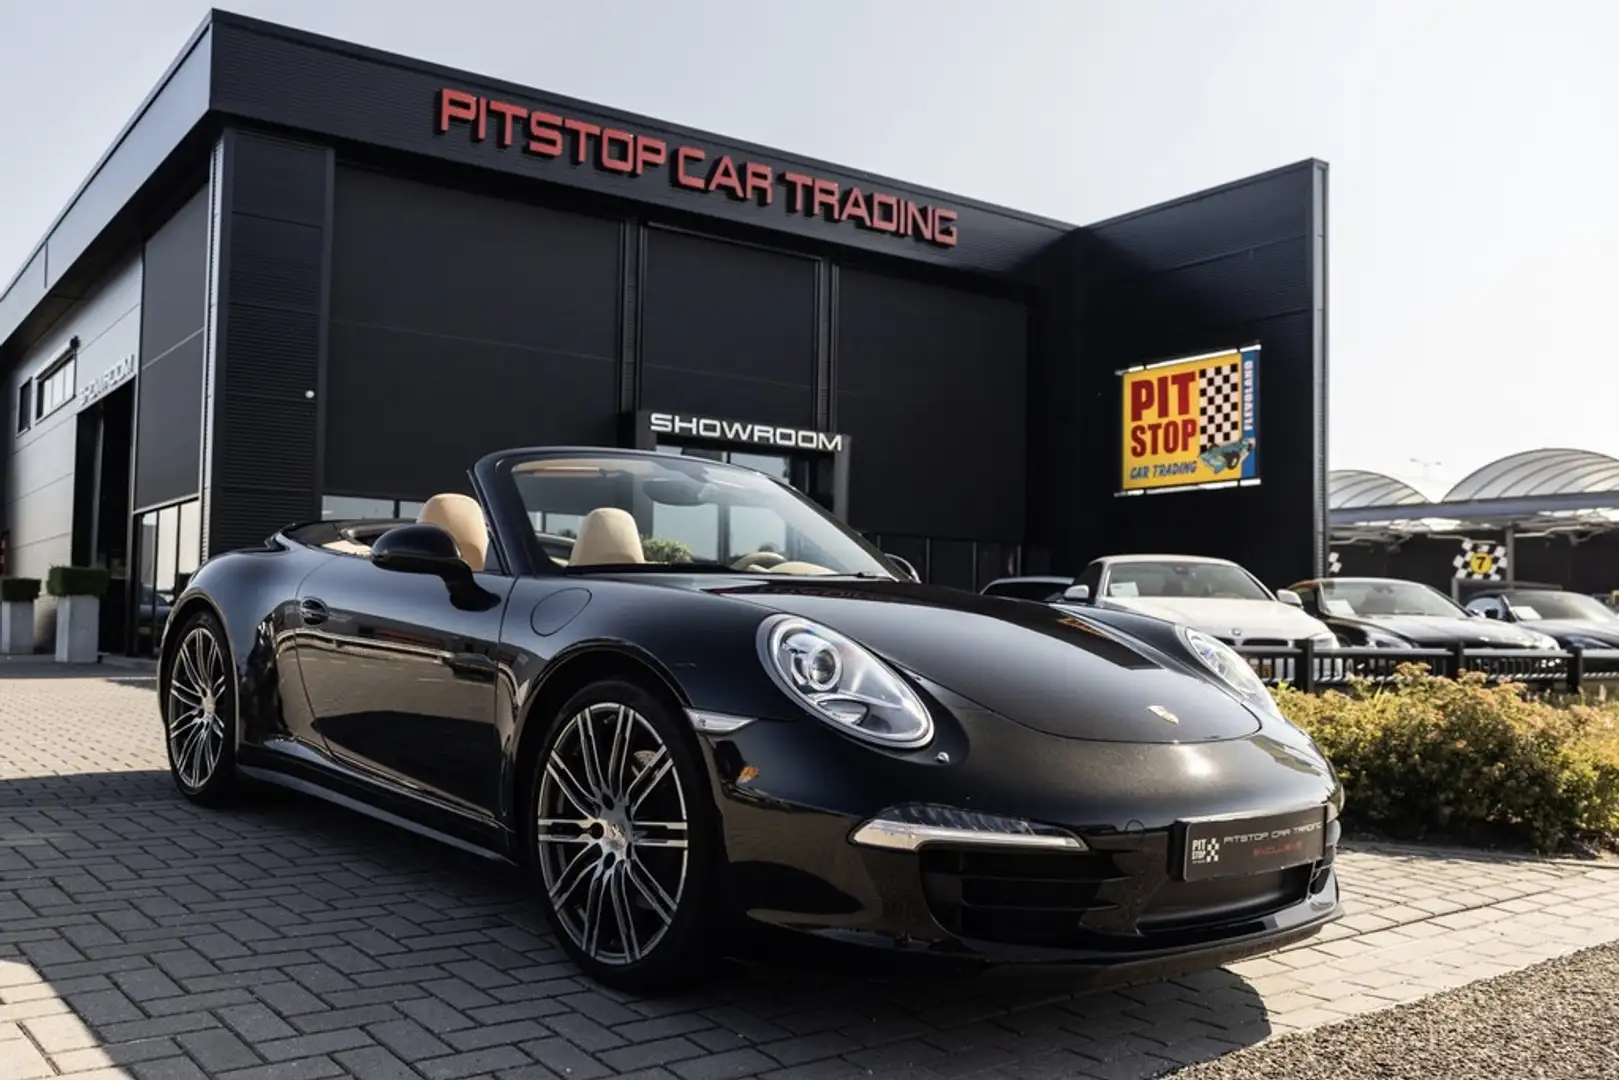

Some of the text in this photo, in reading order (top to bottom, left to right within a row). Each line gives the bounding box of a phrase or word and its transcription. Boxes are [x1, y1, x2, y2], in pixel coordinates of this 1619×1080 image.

[440, 88, 958, 246] PITSTOP CAR TRADING
[1131, 371, 1196, 422] PIT
[1243, 360, 1254, 431] FLEVOLAND
[650, 413, 843, 451] SHOWROOM
[1131, 418, 1198, 458] STOP
[1130, 461, 1198, 480] CAR TRADING
[1476, 556, 1486, 570] 7
[1192, 839, 1207, 851] PIT
[1223, 831, 1269, 844] PITSTOP
[1191, 850, 1206, 860] STOP
